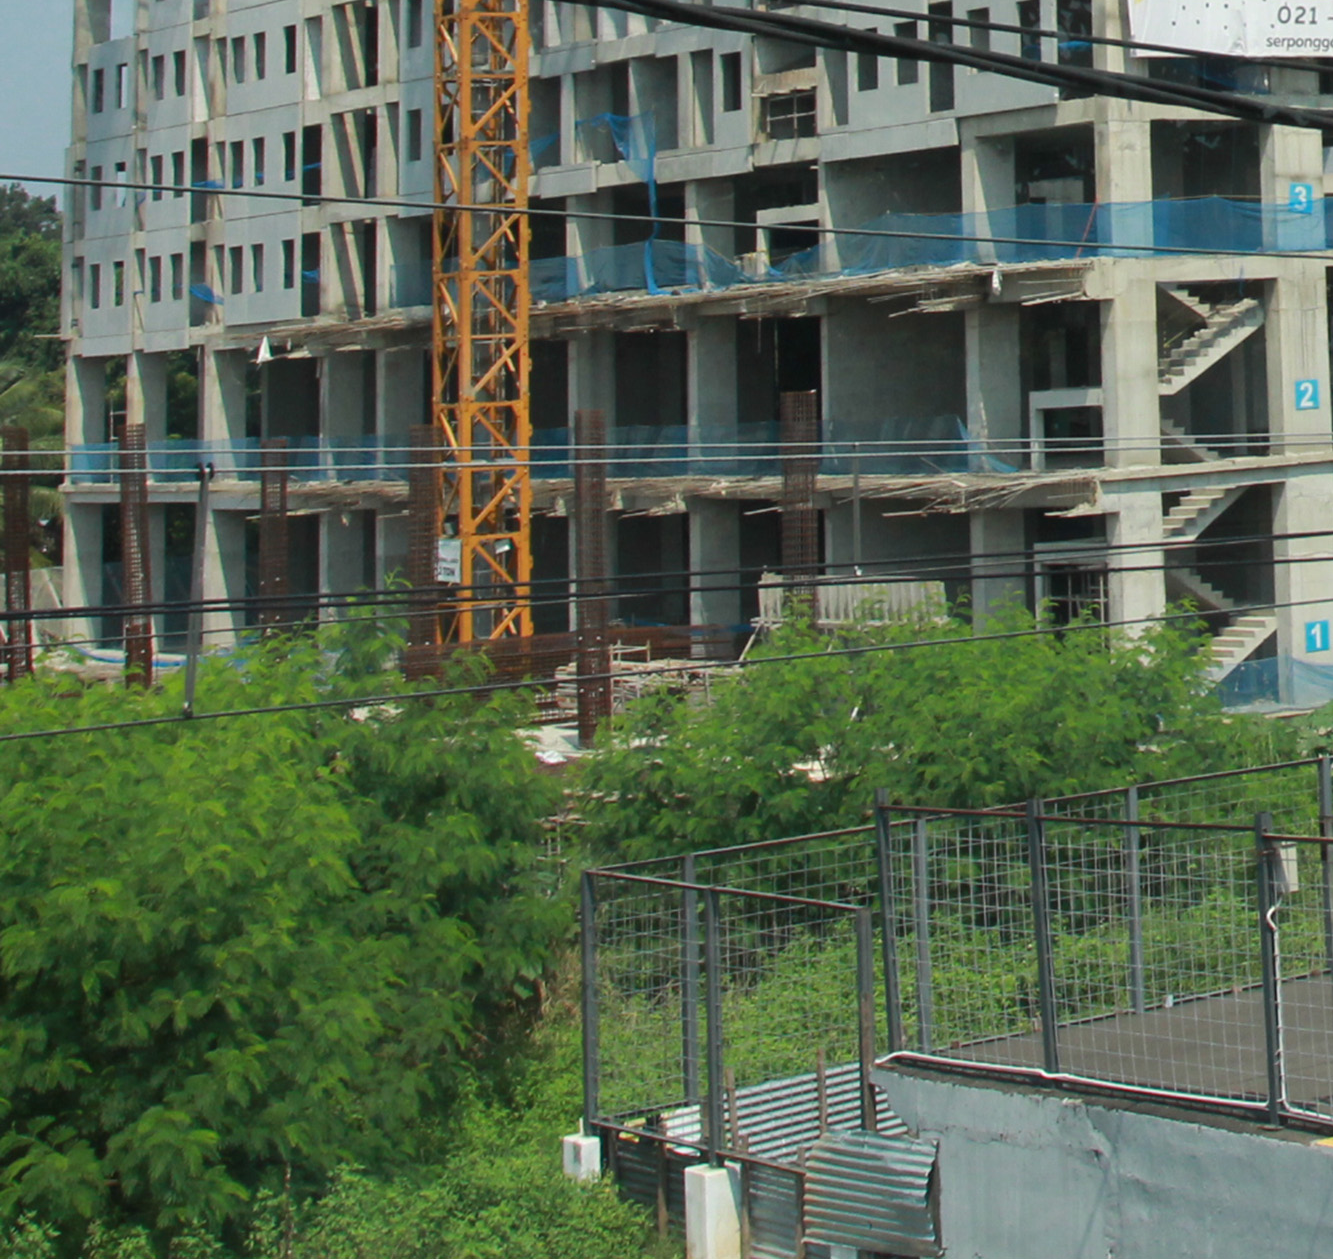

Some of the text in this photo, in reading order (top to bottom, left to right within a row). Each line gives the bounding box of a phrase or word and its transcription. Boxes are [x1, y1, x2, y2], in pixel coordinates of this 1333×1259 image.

[1277, 5, 1318, 25] 021
[1294, 185, 1308, 211] 3
[1300, 382, 1314, 408] 2
[1311, 623, 1322, 649] 1
